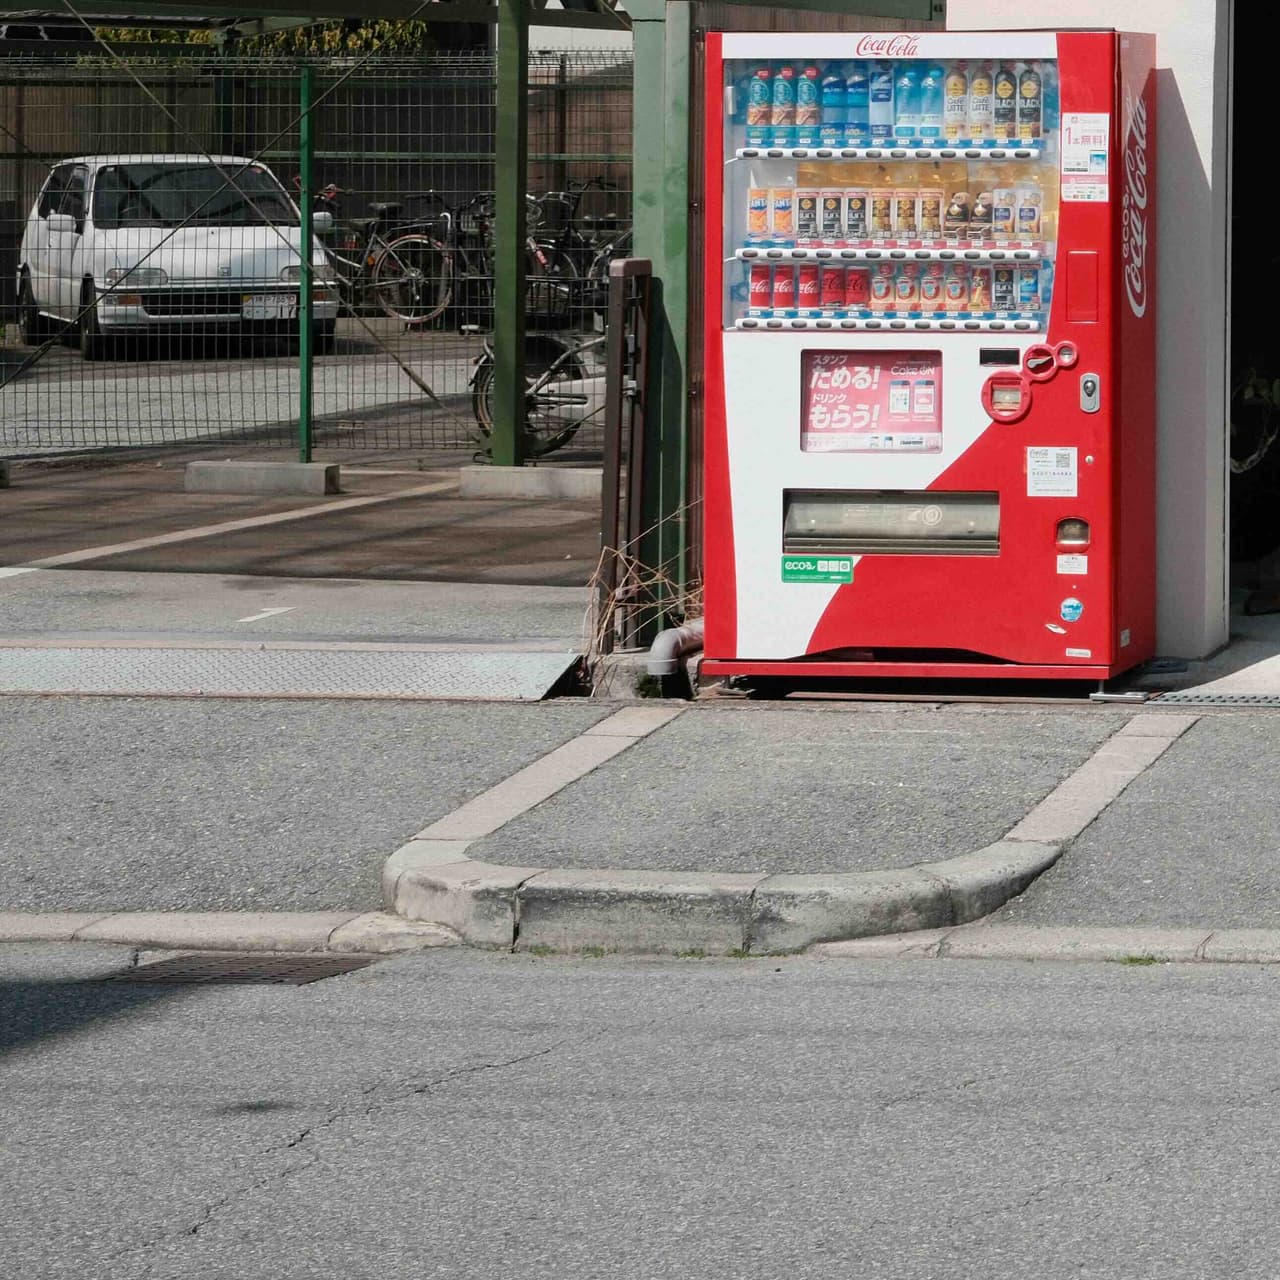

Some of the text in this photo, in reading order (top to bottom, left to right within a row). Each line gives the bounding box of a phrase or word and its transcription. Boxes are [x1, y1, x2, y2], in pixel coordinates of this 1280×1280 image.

[856, 34, 921, 57] Coca-Cola
[812, 355, 848, 365] スタンプ
[810, 365, 881, 390] ためる!
[890, 366, 935, 376] Coke ON
[812, 393, 847, 404] ドリンク
[809, 404, 880, 429] もらう!
